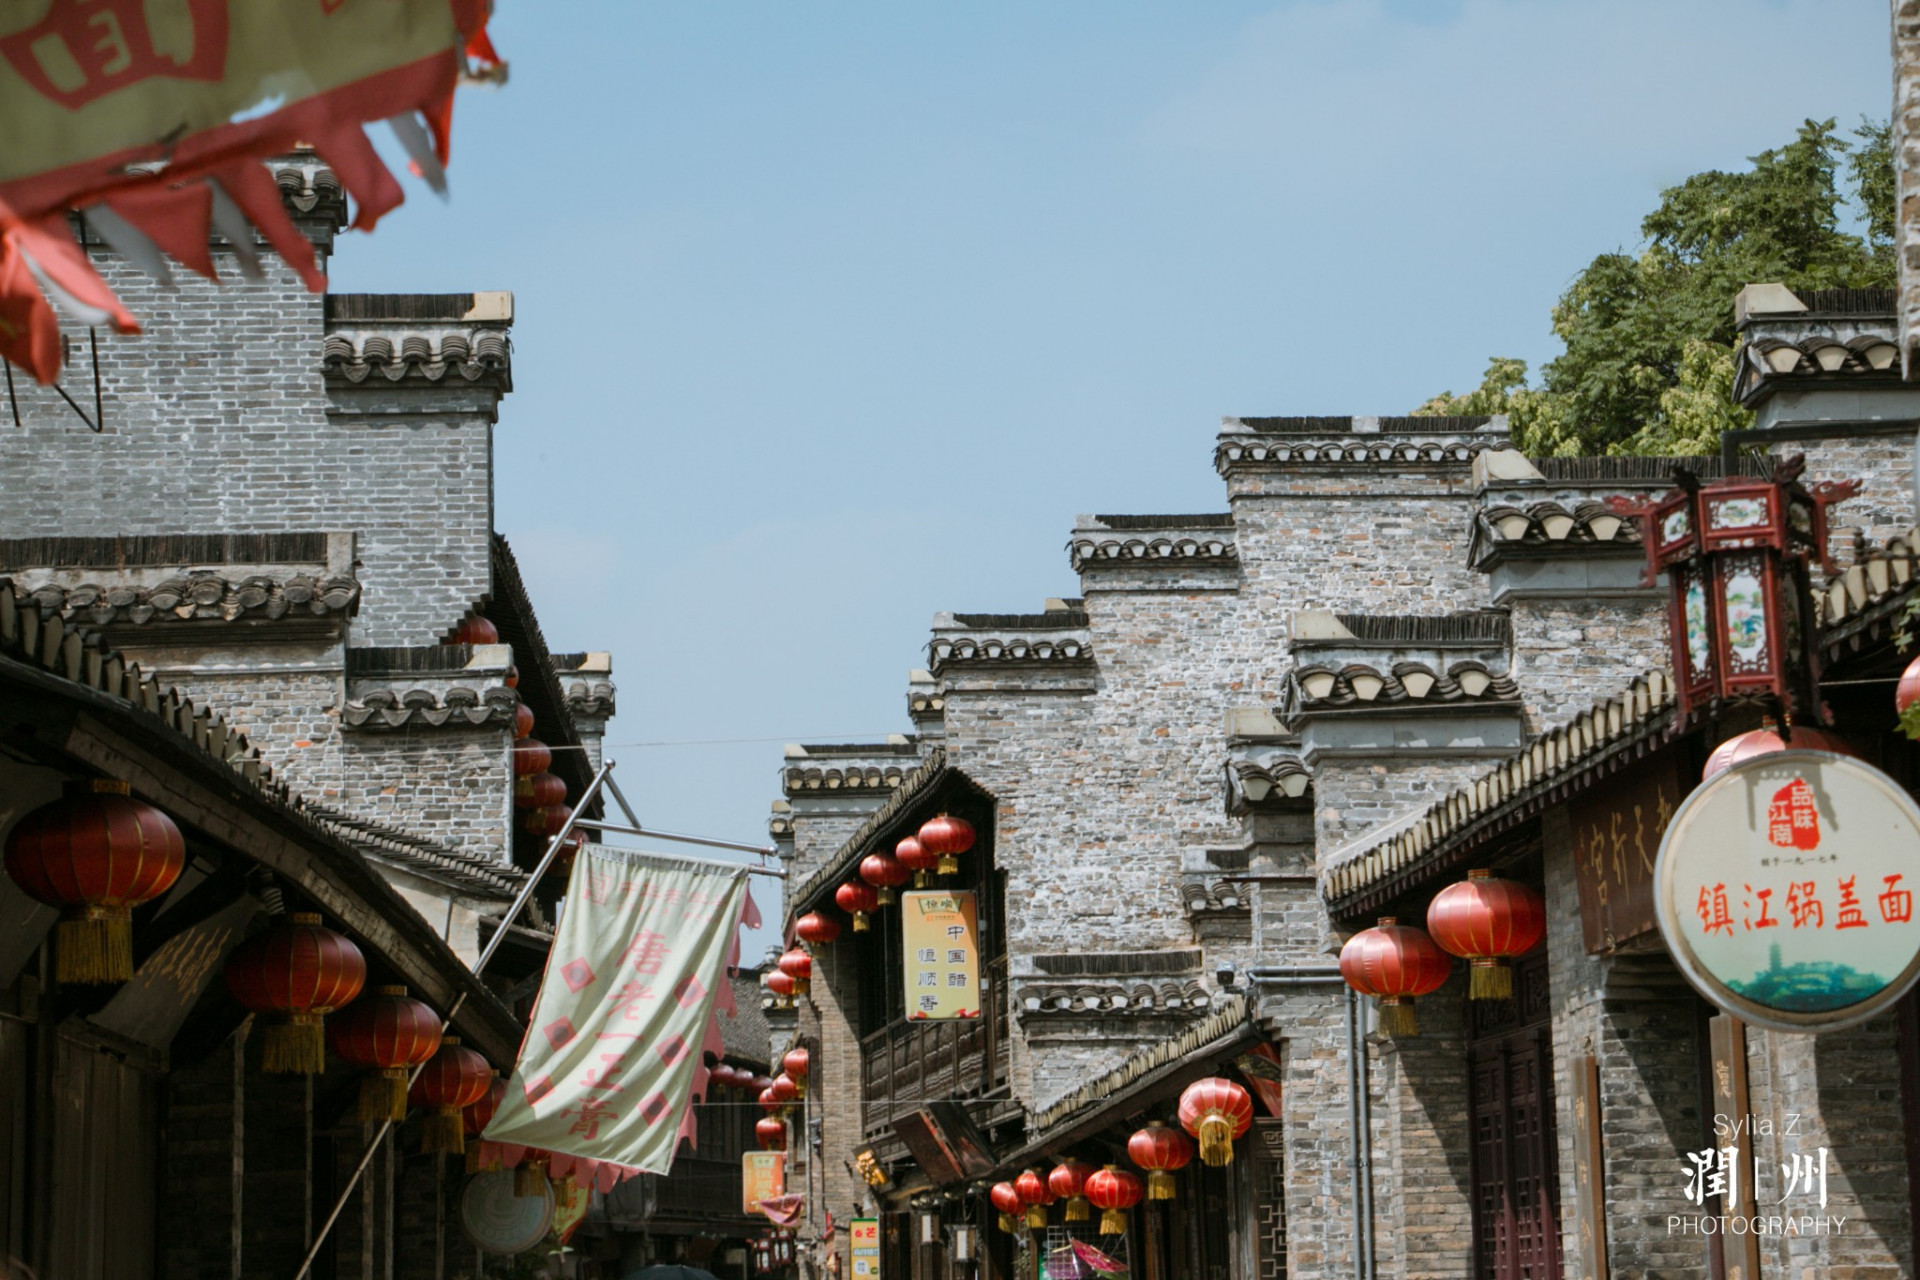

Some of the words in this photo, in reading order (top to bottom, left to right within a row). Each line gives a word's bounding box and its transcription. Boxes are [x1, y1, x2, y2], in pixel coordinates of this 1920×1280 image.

[1770, 800, 1793, 844] 江南
[1791, 784, 1815, 829] 品味
[1695, 873, 1914, 938] 镇江锅盖面
[918, 948, 938, 1011] 恒顺香
[946, 925, 967, 987] 中国醋
